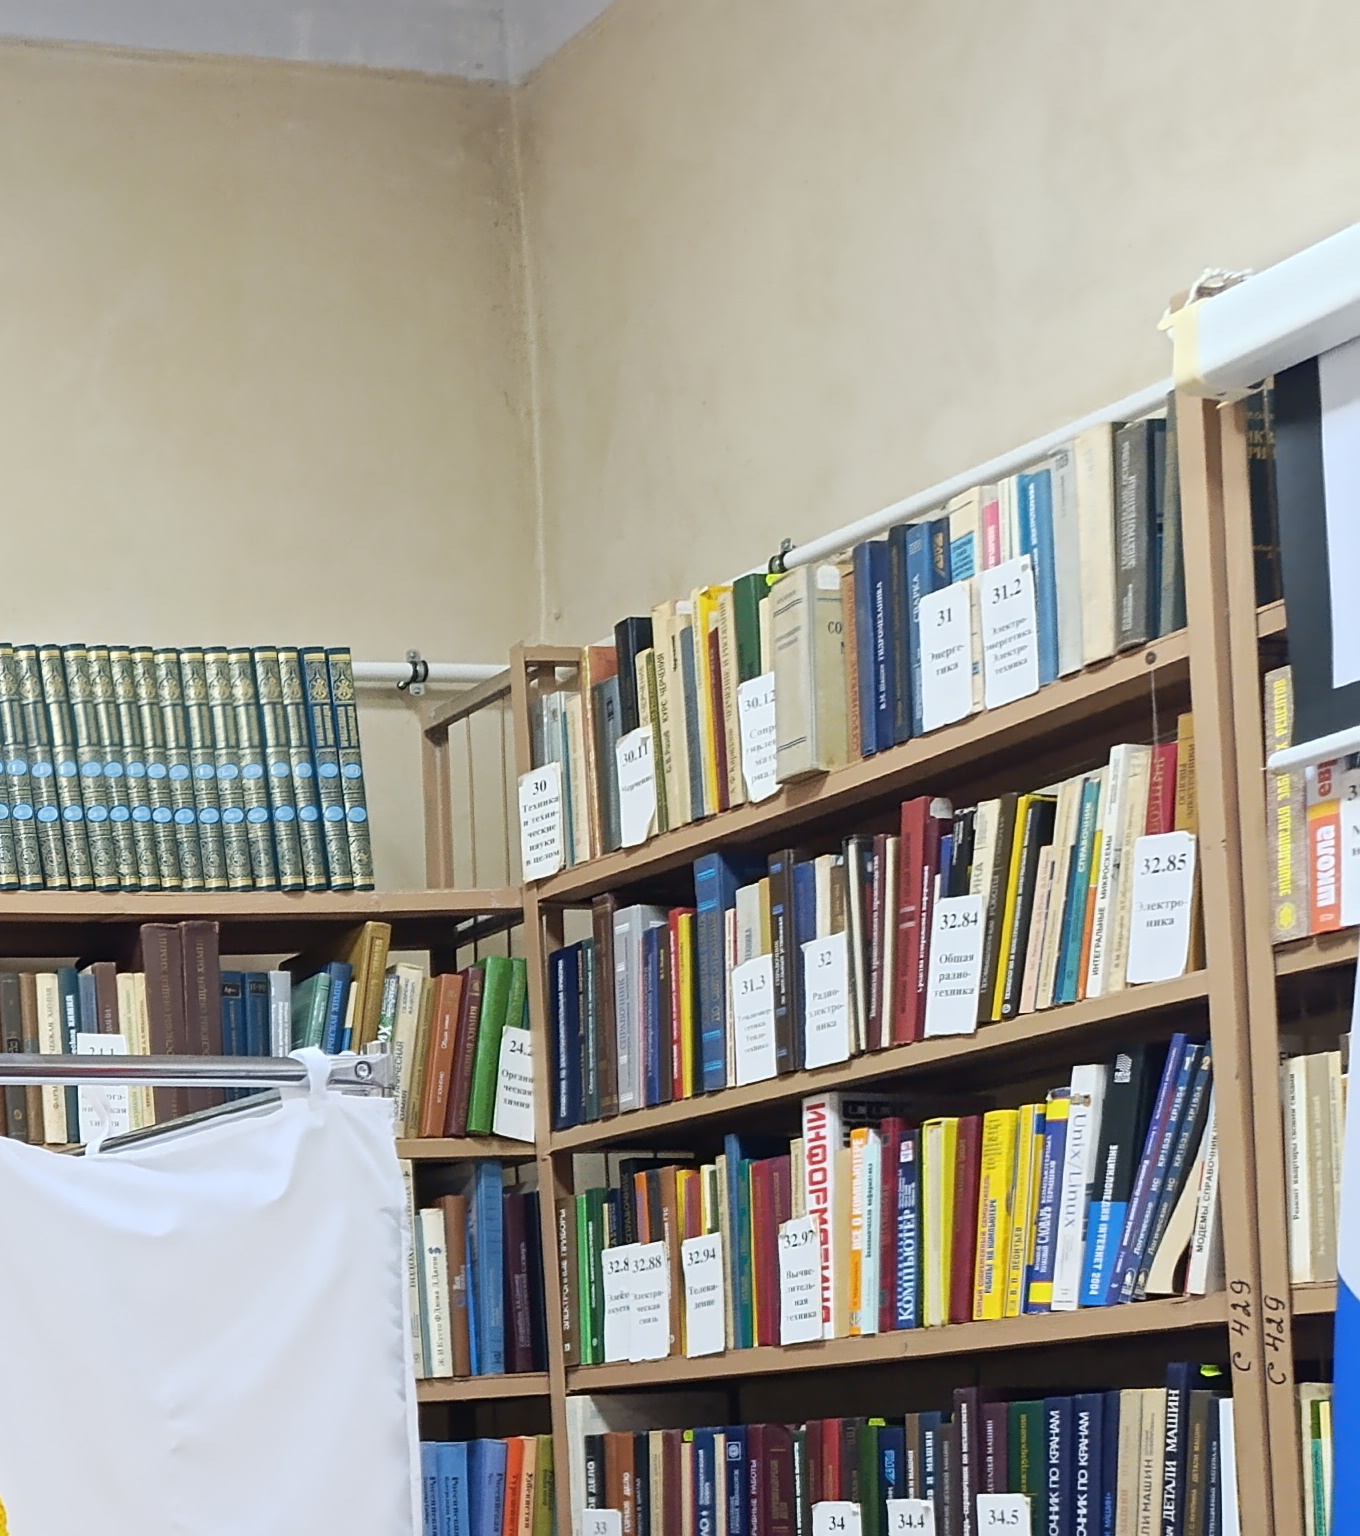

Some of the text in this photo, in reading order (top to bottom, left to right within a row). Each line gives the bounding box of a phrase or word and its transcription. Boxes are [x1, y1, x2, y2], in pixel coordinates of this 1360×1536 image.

[992, 578, 1023, 605] 31.2
[936, 607, 953, 627] 31
[991, 616, 1027, 636] Электро-
[928, 643, 965, 663] Энерге-
[992, 643, 1028, 663] Электро-
[935, 661, 959, 676] тика
[994, 657, 1028, 676] техника
[622, 745, 649, 767] 30.11
[532, 780, 547, 795] 30
[1274, 678, 1292, 896] ЭНЦИКЛОПЕДИЯ РЕЦЕПТОВ
[522, 796, 559, 813] Техника
[530, 811, 559, 826] техни-
[528, 823, 556, 838] ческие
[1077, 802, 1093, 872] СПРАВОЧНИК
[529, 837, 555, 852] науки
[533, 850, 560, 864] целом
[1140, 853, 1187, 875] 32.85
[1315, 825, 1336, 907] школа
[1092, 835, 1113, 975] ИНТЕГРАЛЬНЫЕ МИКРОСХЕМЫ
[1135, 900, 1188, 913] Электро-
[940, 910, 979, 930] 32.84
[1146, 918, 1175, 928] ника
[818, 951, 832, 968] 32
[939, 952, 975, 965] Общая
[741, 975, 766, 995] 31.3
[939, 971, 971, 982] радио-
[812, 988, 839, 1002] Радио-
[934, 986, 975, 998] техника
[816, 1020, 837, 1032] ника
[1064, 1113, 1088, 1228] Unix/Linux
[1099, 1145, 1119, 1221] ЭНЦИКЛОПЕДИЯ
[1195, 1134, 1218, 1252] МОДЕМЫ. СПРАВОЧНИК
[850, 1137, 864, 1250] ВСЕ КОМПЬЮТЕРЕ
[1134, 1202, 1154, 1255] Логические
[1150, 1178, 1160, 1191] ИС
[1156, 1132, 1173, 1167] КР1533
[1148, 1202, 1169, 1255] Логические
[1166, 1178, 1176, 1191] ИС
[1172, 1132, 1189, 1167] КР1533
[558, 1209, 568, 1257] ПРИБОРЫ
[1038, 1206, 1052, 1244] СЛОВАРЬ
[783, 1230, 816, 1249] 32.97
[984, 1199, 997, 1294] РАБОТЫ НА КОМПЬЮТЕРЕ
[632, 1255, 662, 1274] 32.88
[686, 1247, 716, 1266] 32.94
[898, 1208, 917, 1320] КОМПЬЮТЕР
[786, 1268, 815, 1279] Вычис-
[1088, 1272, 1100, 1295] 2004
[689, 1283, 719, 1297] Телеви-
[793, 1298, 808, 1308] ная
[1230, 1280, 1252, 1335] 429
[786, 1311, 817, 1322] техника
[1265, 1295, 1286, 1351] 429
[1164, 1389, 1180, 1452] МАШИН
[1048, 1410, 1061, 1463] КРАНАМ
[1078, 1412, 1091, 1466] КРАНАМ
[750, 1459, 758, 1494] РАБОТЫ
[1049, 1468, 1060, 1488] ПО
[1077, 1469, 1089, 1490] ПО
[1139, 1458, 1153, 1511] МАШИН
[524, 1472, 533, 1529] Узбекистан
[1162, 1460, 1177, 1522] ДЕТАЛИ
[828, 1516, 845, 1531] 34
[898, 1513, 925, 1530] 34.4
[988, 1509, 1019, 1526] 34.5
[594, 1521, 607, 1535] 33
